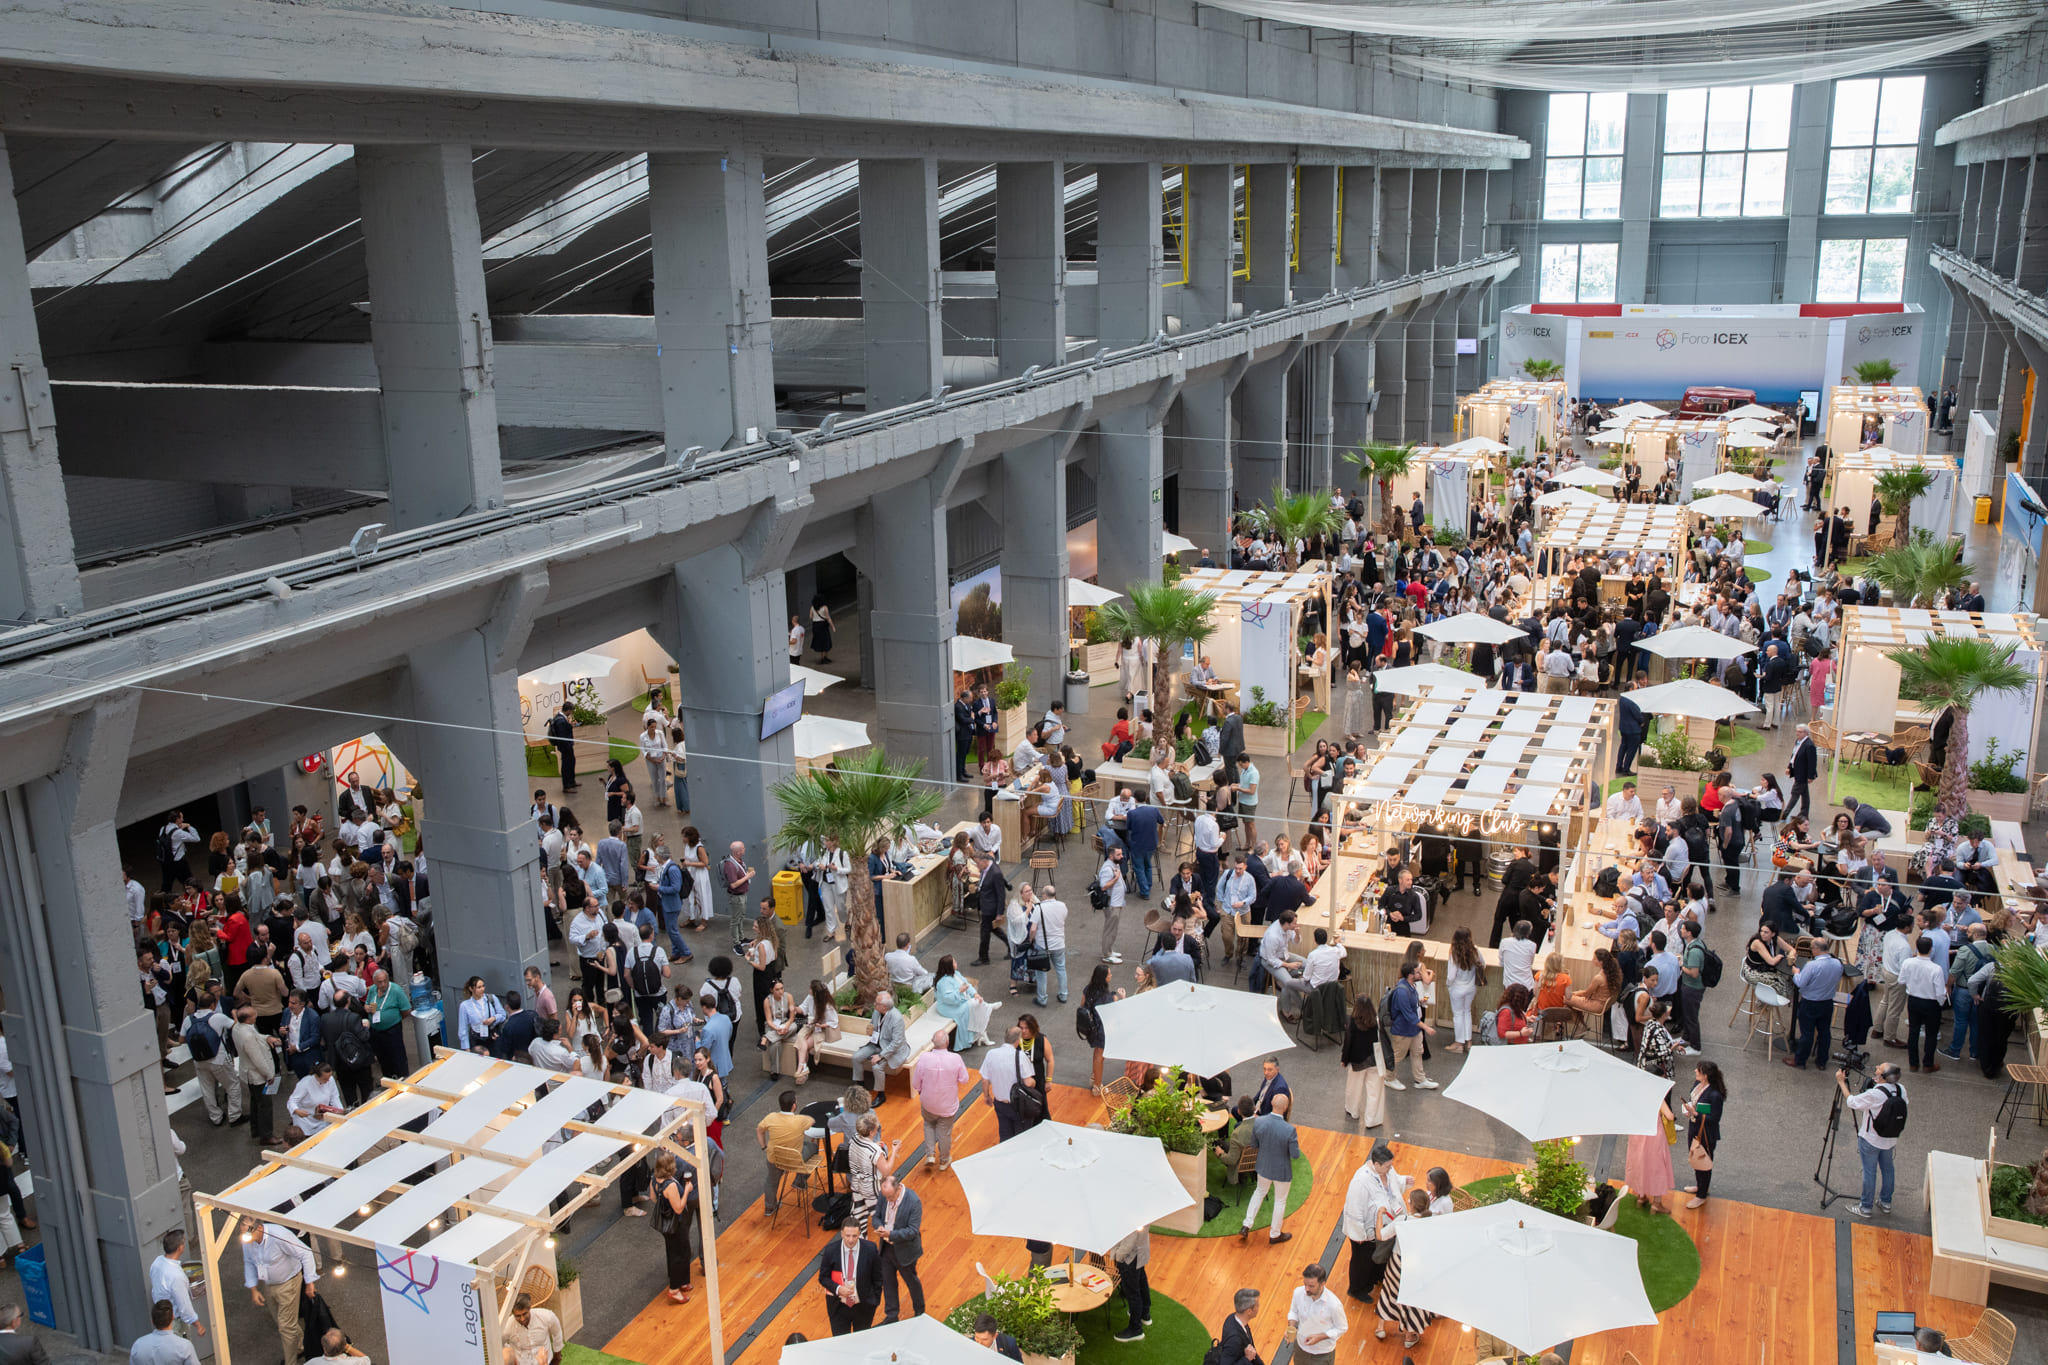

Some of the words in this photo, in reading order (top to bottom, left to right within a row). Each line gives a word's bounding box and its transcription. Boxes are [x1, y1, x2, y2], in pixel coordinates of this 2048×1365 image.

[1533, 327, 1551, 337] ICEX
[1681, 332, 1710, 344] Foro
[1713, 333, 1748, 344] ICEX
[1891, 325, 1912, 337] ICEX
[535, 690, 561, 712] Foro
[564, 677, 594, 699] ICEX
[1375, 799, 1475, 835] Networking
[1480, 808, 1525, 835] Club
[461, 1283, 478, 1346] Lagos
